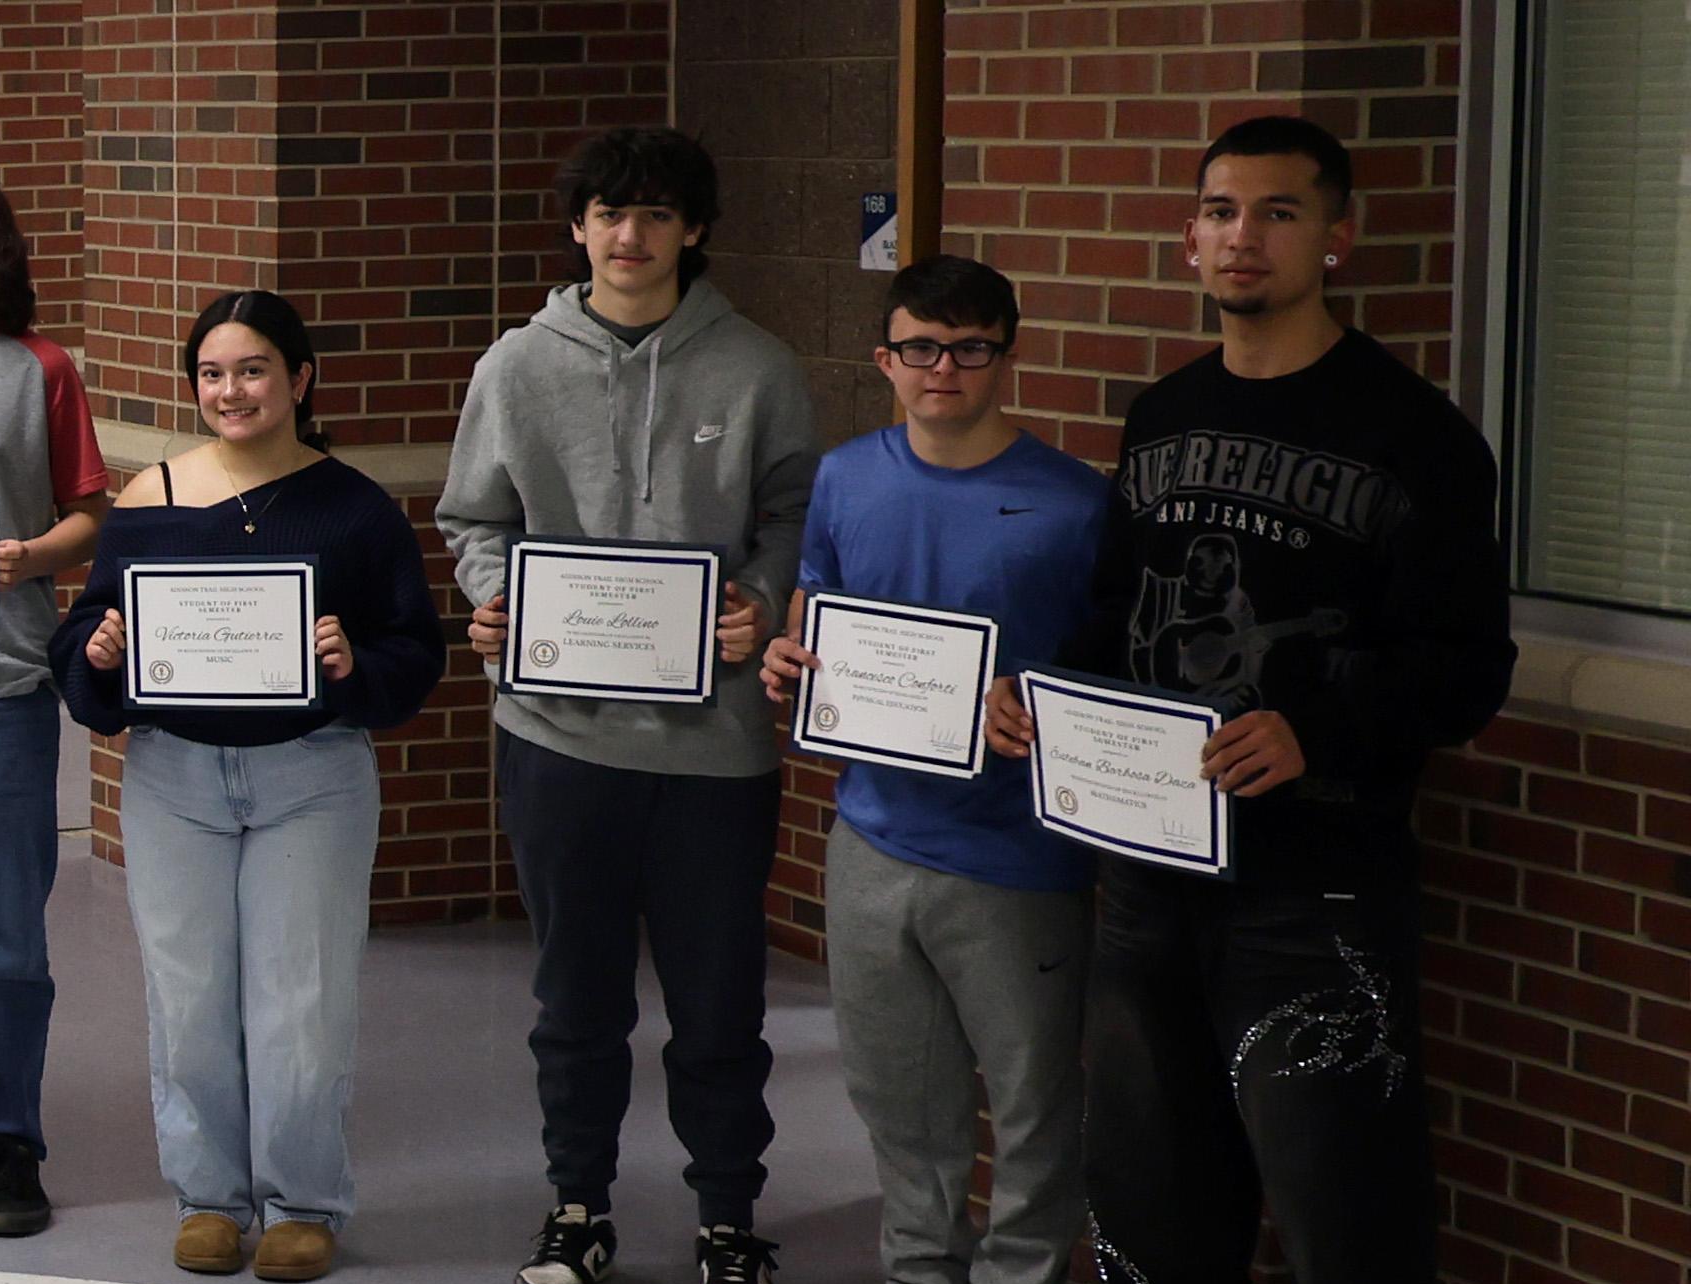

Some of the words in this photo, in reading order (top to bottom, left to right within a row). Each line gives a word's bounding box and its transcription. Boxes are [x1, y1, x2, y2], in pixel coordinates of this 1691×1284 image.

[865, 194, 886, 213] 168
[562, 609, 603, 625] Louie
[606, 612, 658, 628] Lollino
[155, 626, 210, 640] Victoria
[213, 626, 282, 642] Gutierrez
[563, 638, 609, 647] LEARNING
[612, 641, 655, 650] SERVICES
